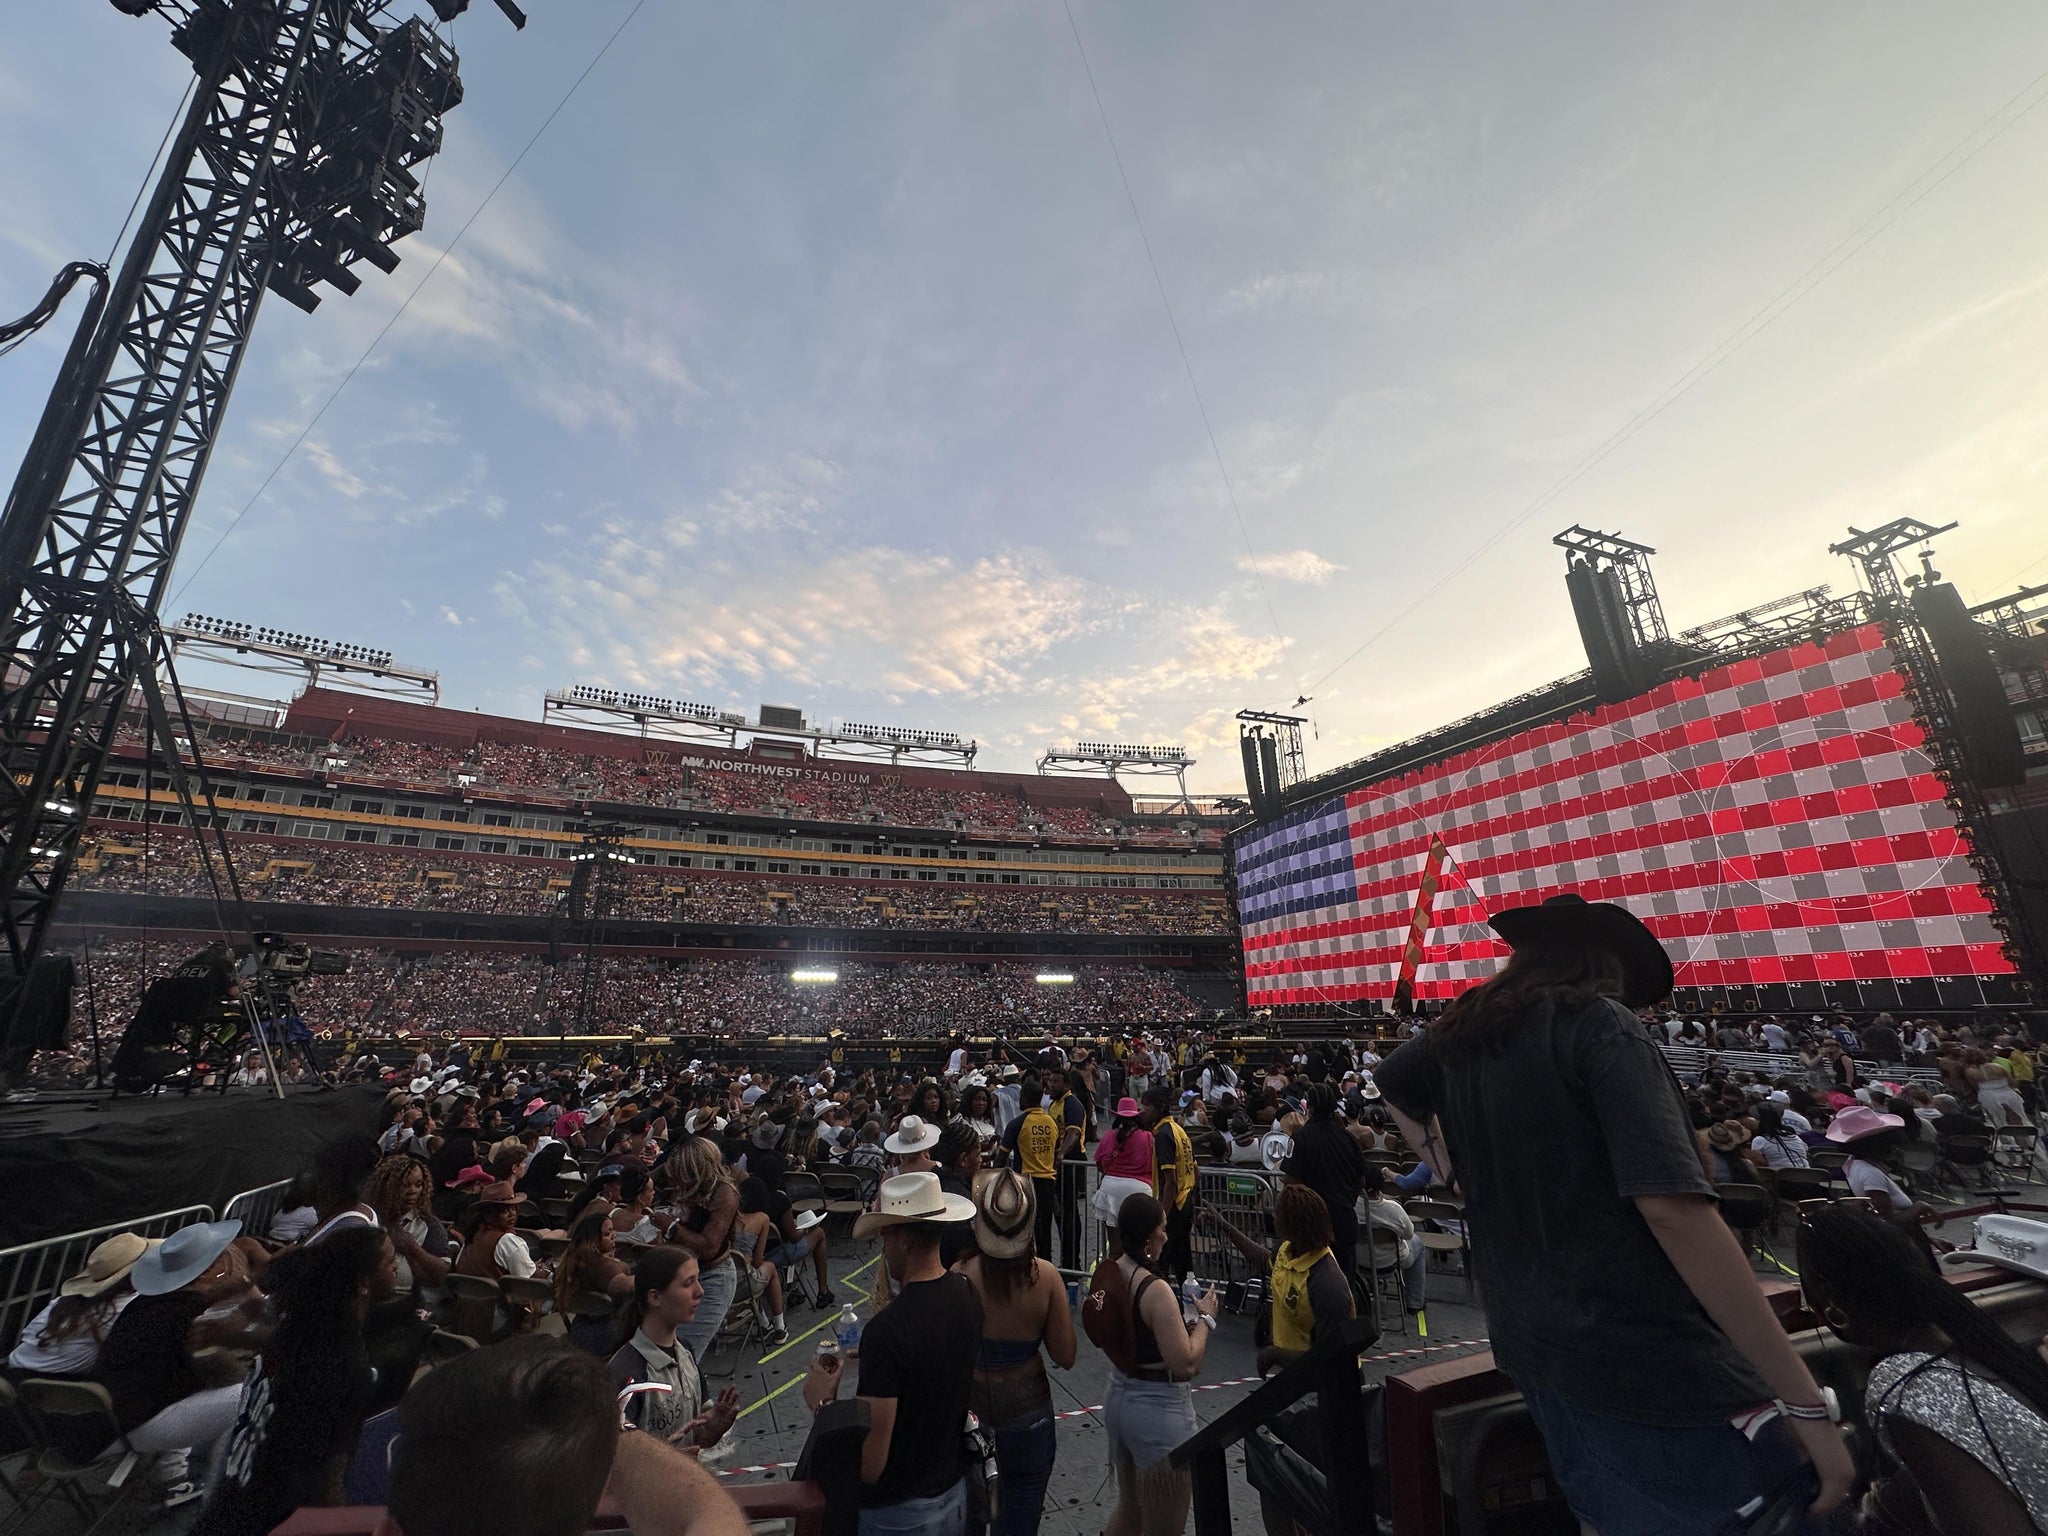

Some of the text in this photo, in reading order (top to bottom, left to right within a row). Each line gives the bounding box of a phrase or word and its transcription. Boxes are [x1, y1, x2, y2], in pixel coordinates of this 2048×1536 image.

[709, 759, 803, 778] NORTHWEST
[805, 769, 870, 784] STADIUM
[1031, 1125, 1051, 1136] CSC
[1032, 1137, 1051, 1146] EVENT
[1032, 1145, 1051, 1155] STAFF
